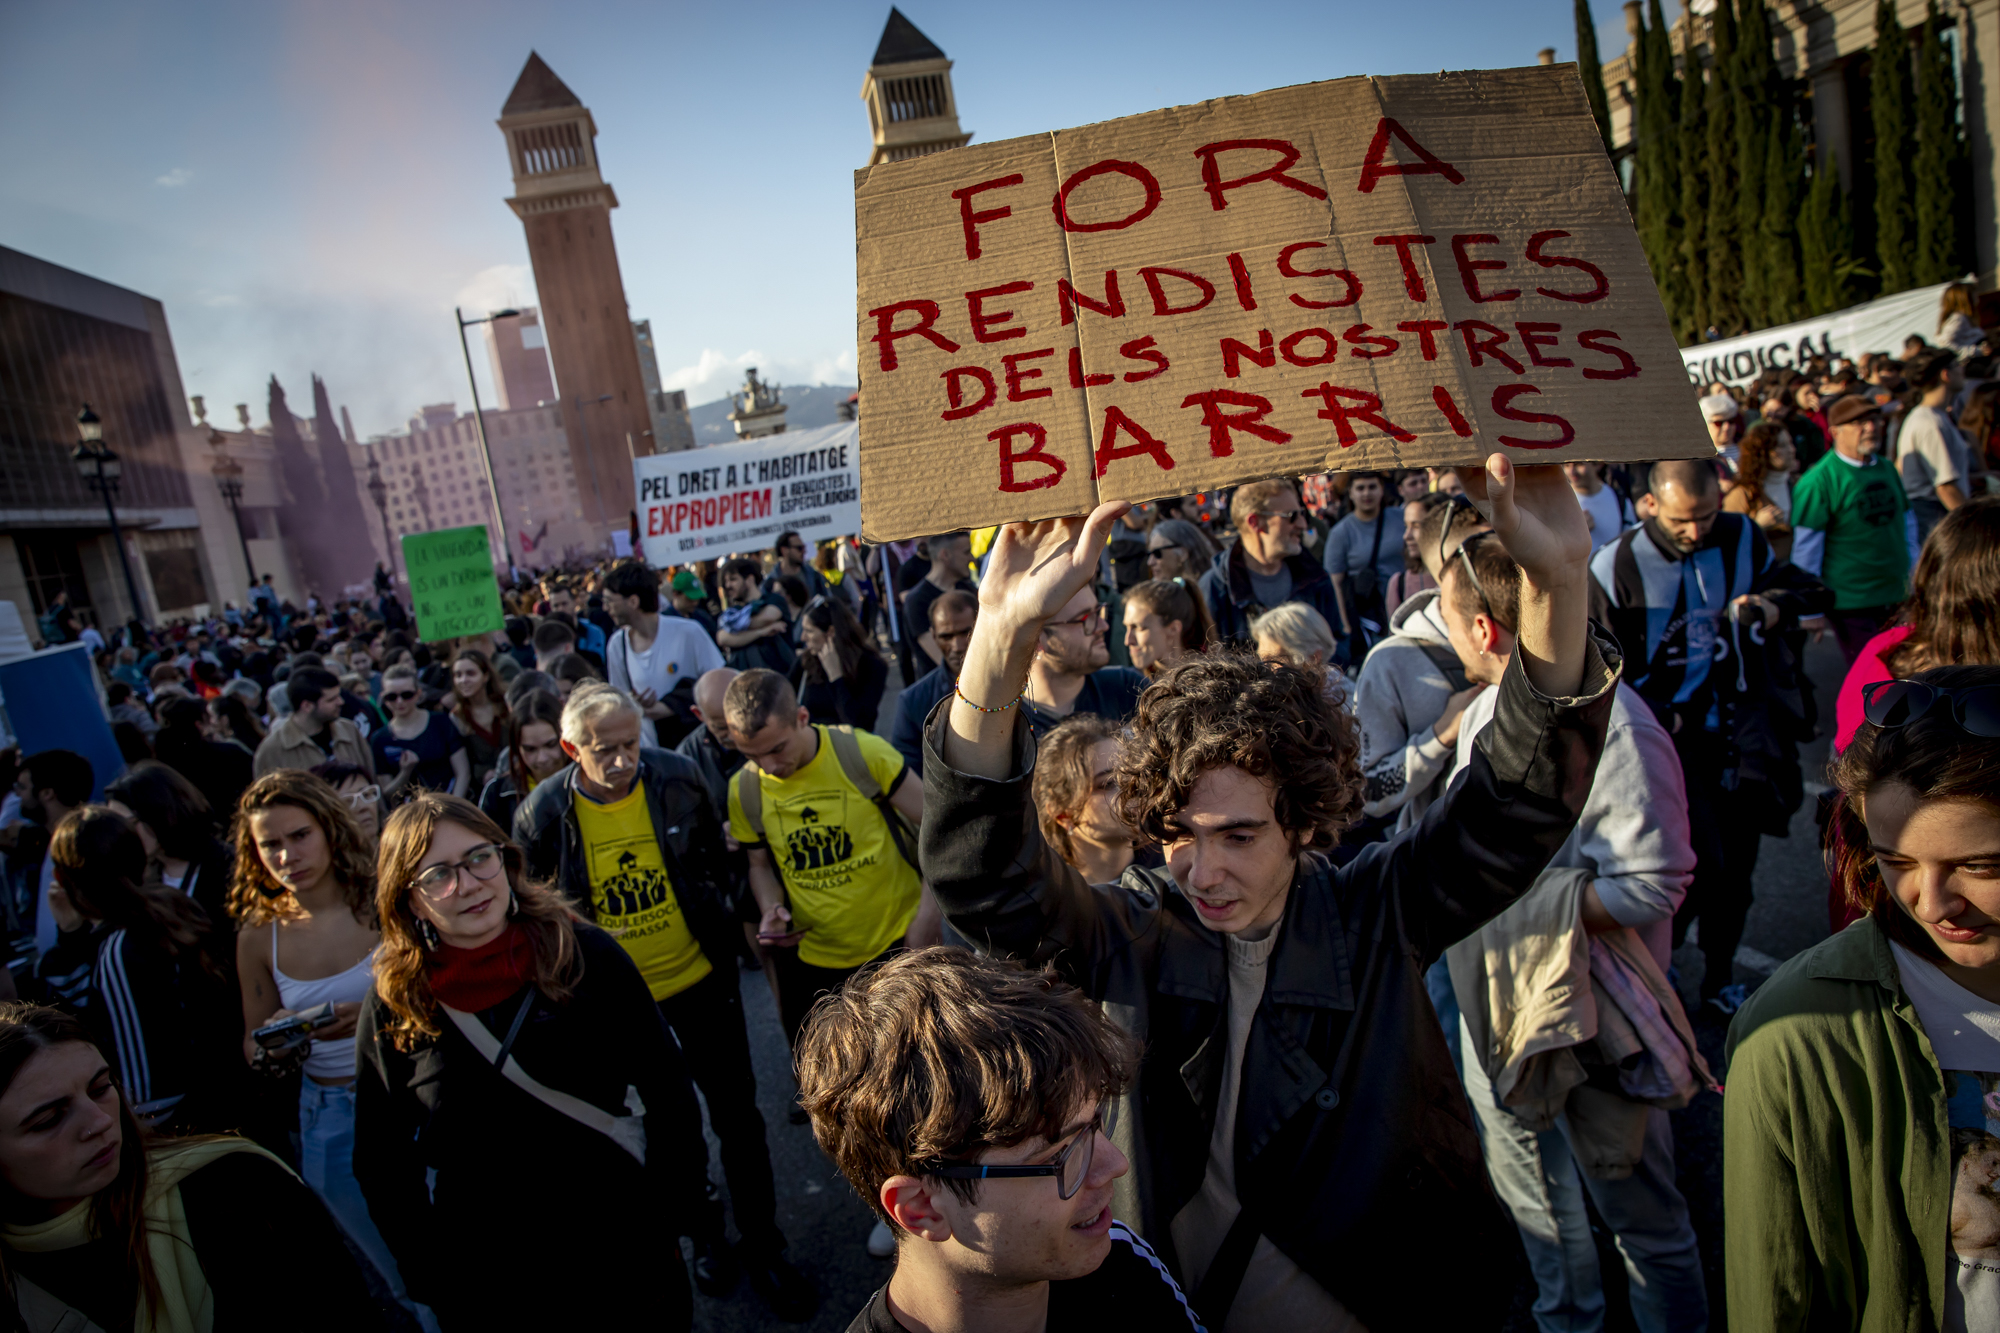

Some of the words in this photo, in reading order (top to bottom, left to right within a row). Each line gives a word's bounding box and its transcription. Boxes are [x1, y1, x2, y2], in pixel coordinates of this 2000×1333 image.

[951, 117, 1465, 260] FORA
[869, 229, 1609, 372] RENDISTES
[940, 335, 1170, 420] DELS
[1220, 319, 1642, 380] NOSTRES
[1686, 331, 1842, 386] SINDICAL
[987, 381, 1575, 492] BARRIS
[641, 475, 671, 502] PEL
[679, 467, 721, 496] DRET
[726, 464, 737, 488] A
[744, 445, 848, 485] L'HABITATGE
[780, 485, 788, 498] A
[780, 488, 857, 514] ESPECULADORS
[647, 487, 772, 538] EXPROPIEM
